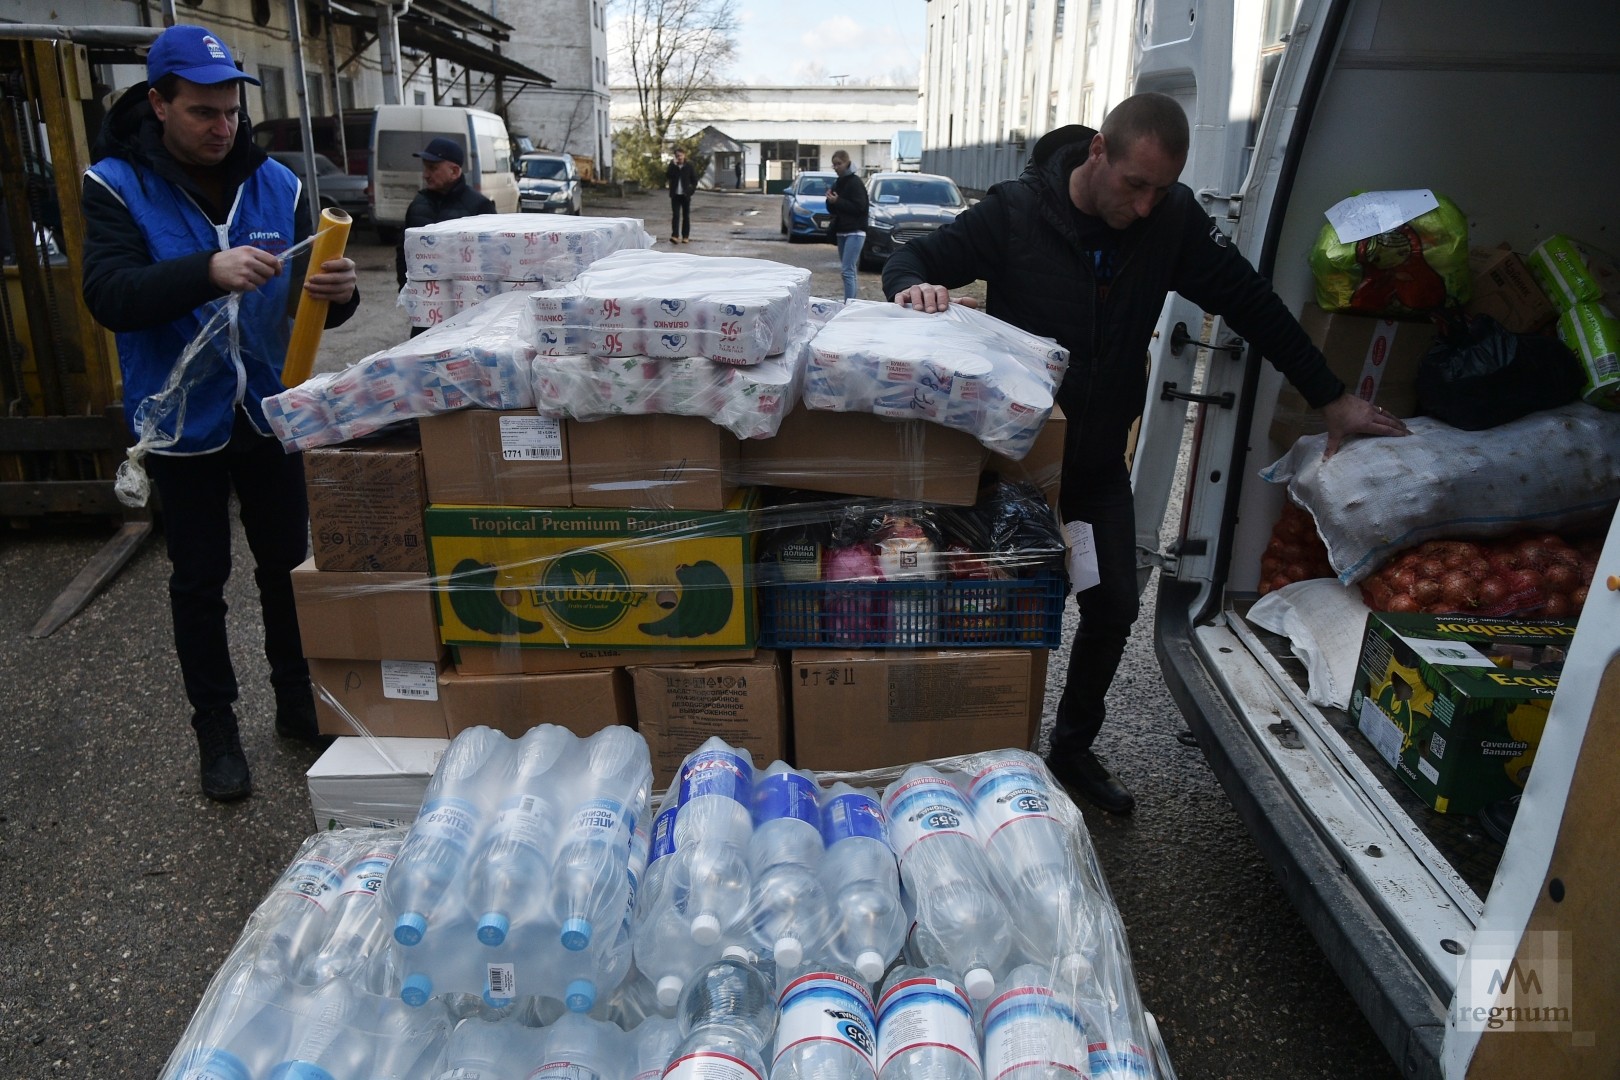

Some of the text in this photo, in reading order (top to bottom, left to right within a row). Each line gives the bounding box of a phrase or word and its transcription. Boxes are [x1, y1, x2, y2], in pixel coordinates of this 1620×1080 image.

[1504, 259, 1532, 298] Чайник
[653, 320, 689, 329] ОБЛАЧКО
[712, 354, 747, 365] ОБЛАЧКО
[503, 449, 522, 458] 1771
[469, 516, 698, 534] Tropical Premium Bananas
[530, 582, 648, 607] Ecuasabor
[1436, 623, 1576, 637] cuasabor
[679, 708, 737, 717] ВЫМОРОЖЕННОЕ
[1480, 740, 1528, 749] Cavendish
[1482, 748, 1523, 756] Bananas
[1019, 798, 1047, 811] 555
[929, 814, 959, 828] 555
[367, 880, 381, 890] 55
[847, 1026, 873, 1055] 555
